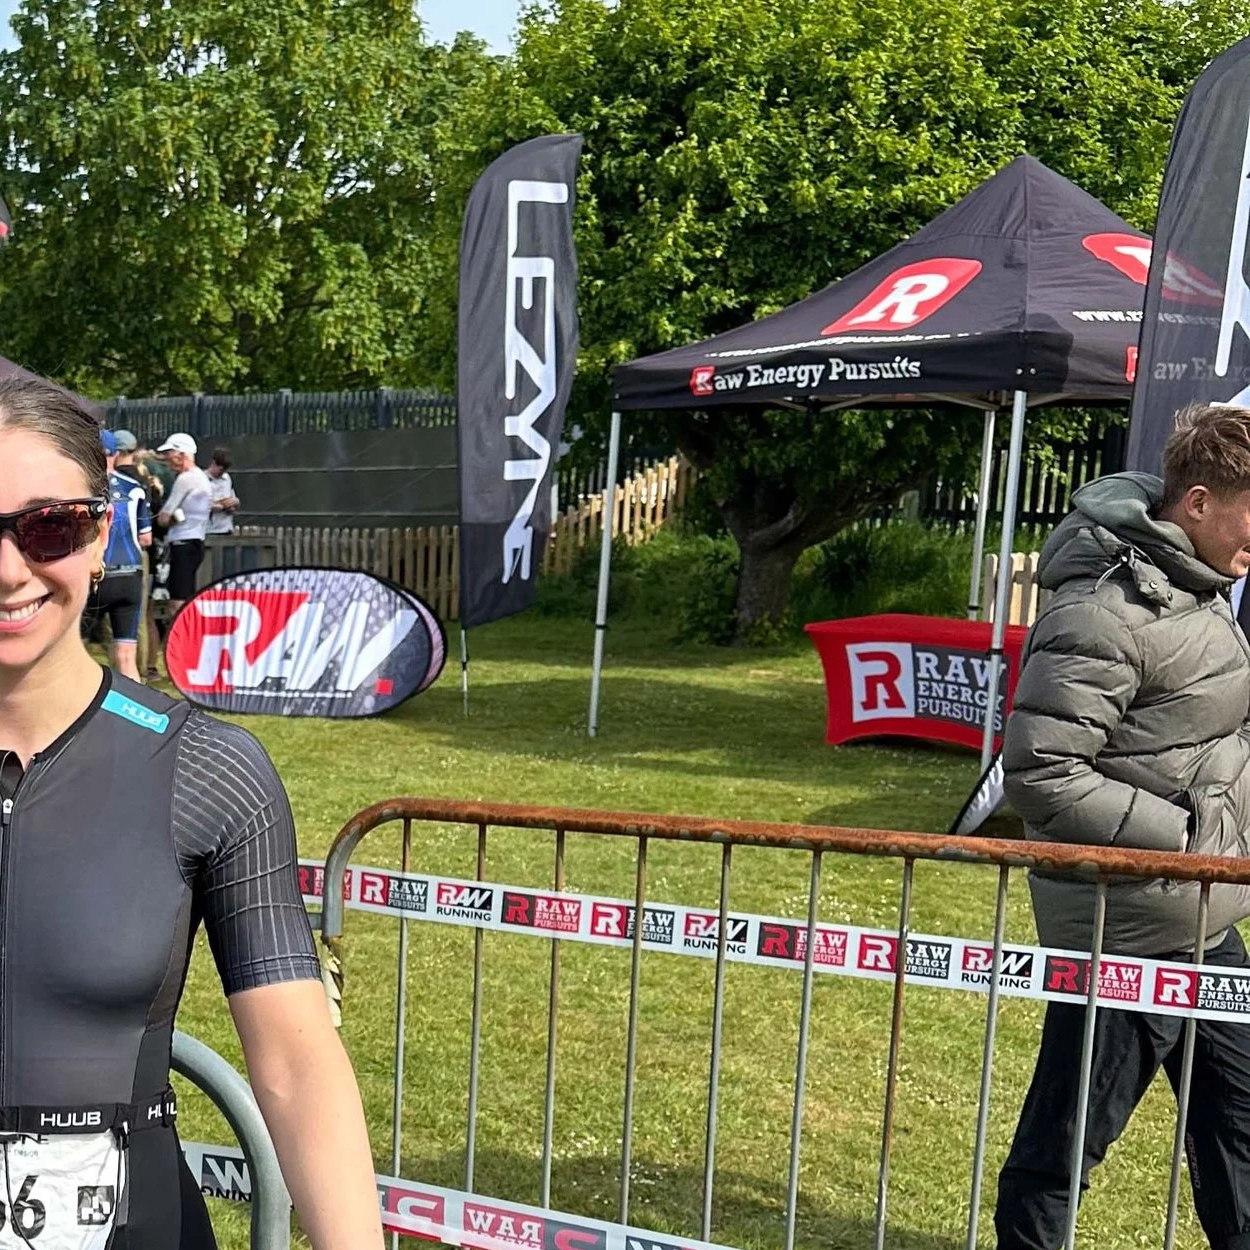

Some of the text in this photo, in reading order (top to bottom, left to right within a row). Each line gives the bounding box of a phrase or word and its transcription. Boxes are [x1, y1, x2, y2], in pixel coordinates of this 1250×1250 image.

[747, 362, 825, 388] Energy
[829, 355, 921, 381] Pursuits
[502, 180, 569, 585] LEZYNE
[856, 651, 906, 711] R
[362, 877, 385, 902] R
[388, 876, 428, 896] RAW
[388, 891, 427, 905] ENERGY
[440, 884, 492, 909] RAW
[436, 905, 492, 922] RUNNING
[535, 897, 581, 917] RAW
[535, 910, 580, 925] ENERGY
[594, 905, 625, 936] R
[683, 937, 747, 955] RUNNNG
[862, 937, 893, 970] R
[904, 964, 948, 980] URSUITS
[905, 953, 949, 971] NERGY
[1158, 971, 1191, 1005] R
[1199, 975, 1250, 995] RAW
[40, 1111, 101, 1127] HUUB
